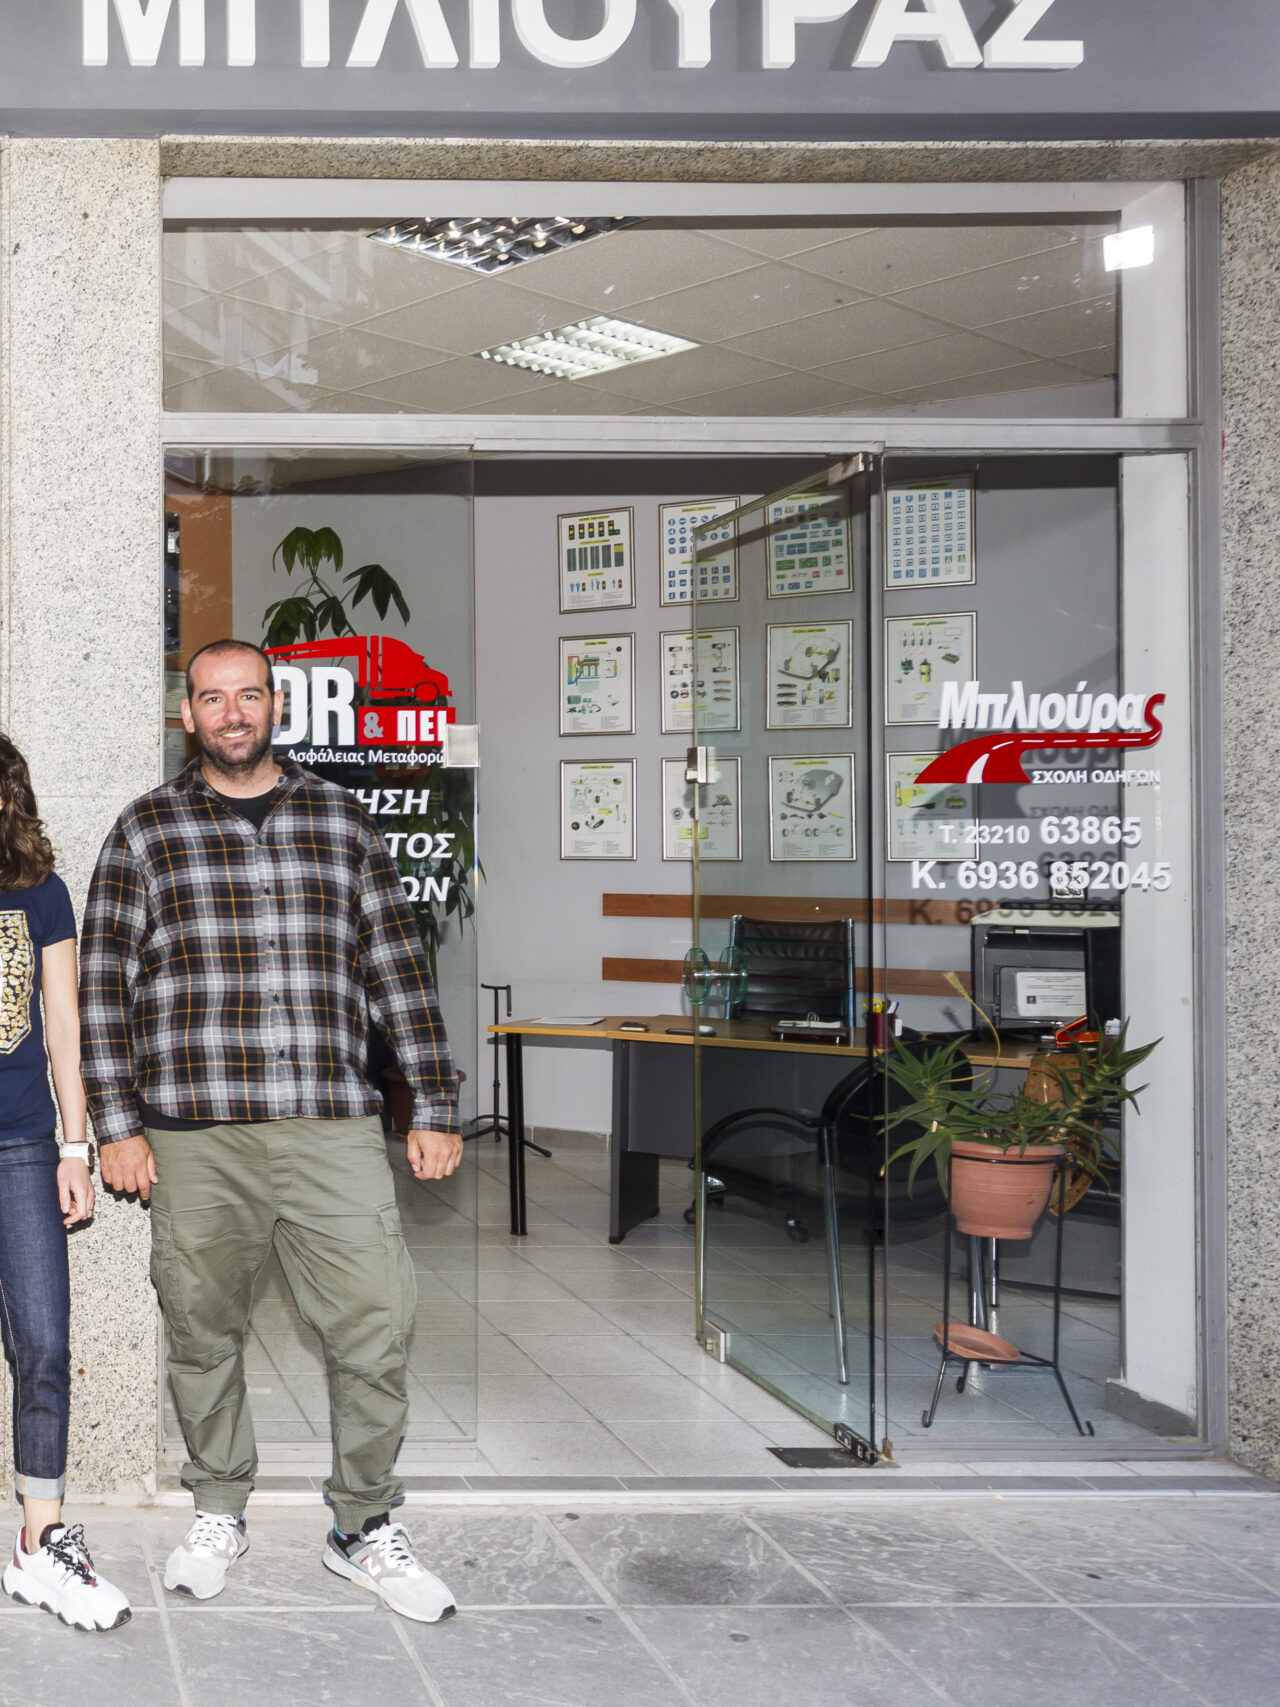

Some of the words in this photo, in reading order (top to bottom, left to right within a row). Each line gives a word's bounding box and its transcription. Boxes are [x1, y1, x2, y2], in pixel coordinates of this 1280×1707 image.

[938, 680, 1166, 733] Μπλιούρας
[1032, 770, 1088, 784] ΣΧΟΛΗ
[1090, 769, 1160, 784] ΟΔΗΓΩΝ
[347, 788, 431, 815] ΗΣΗ
[963, 825, 1031, 844] 23210
[1039, 815, 1143, 845] 63865
[958, 860, 1039, 890] 6936
[1049, 860, 1172, 890] 852045
